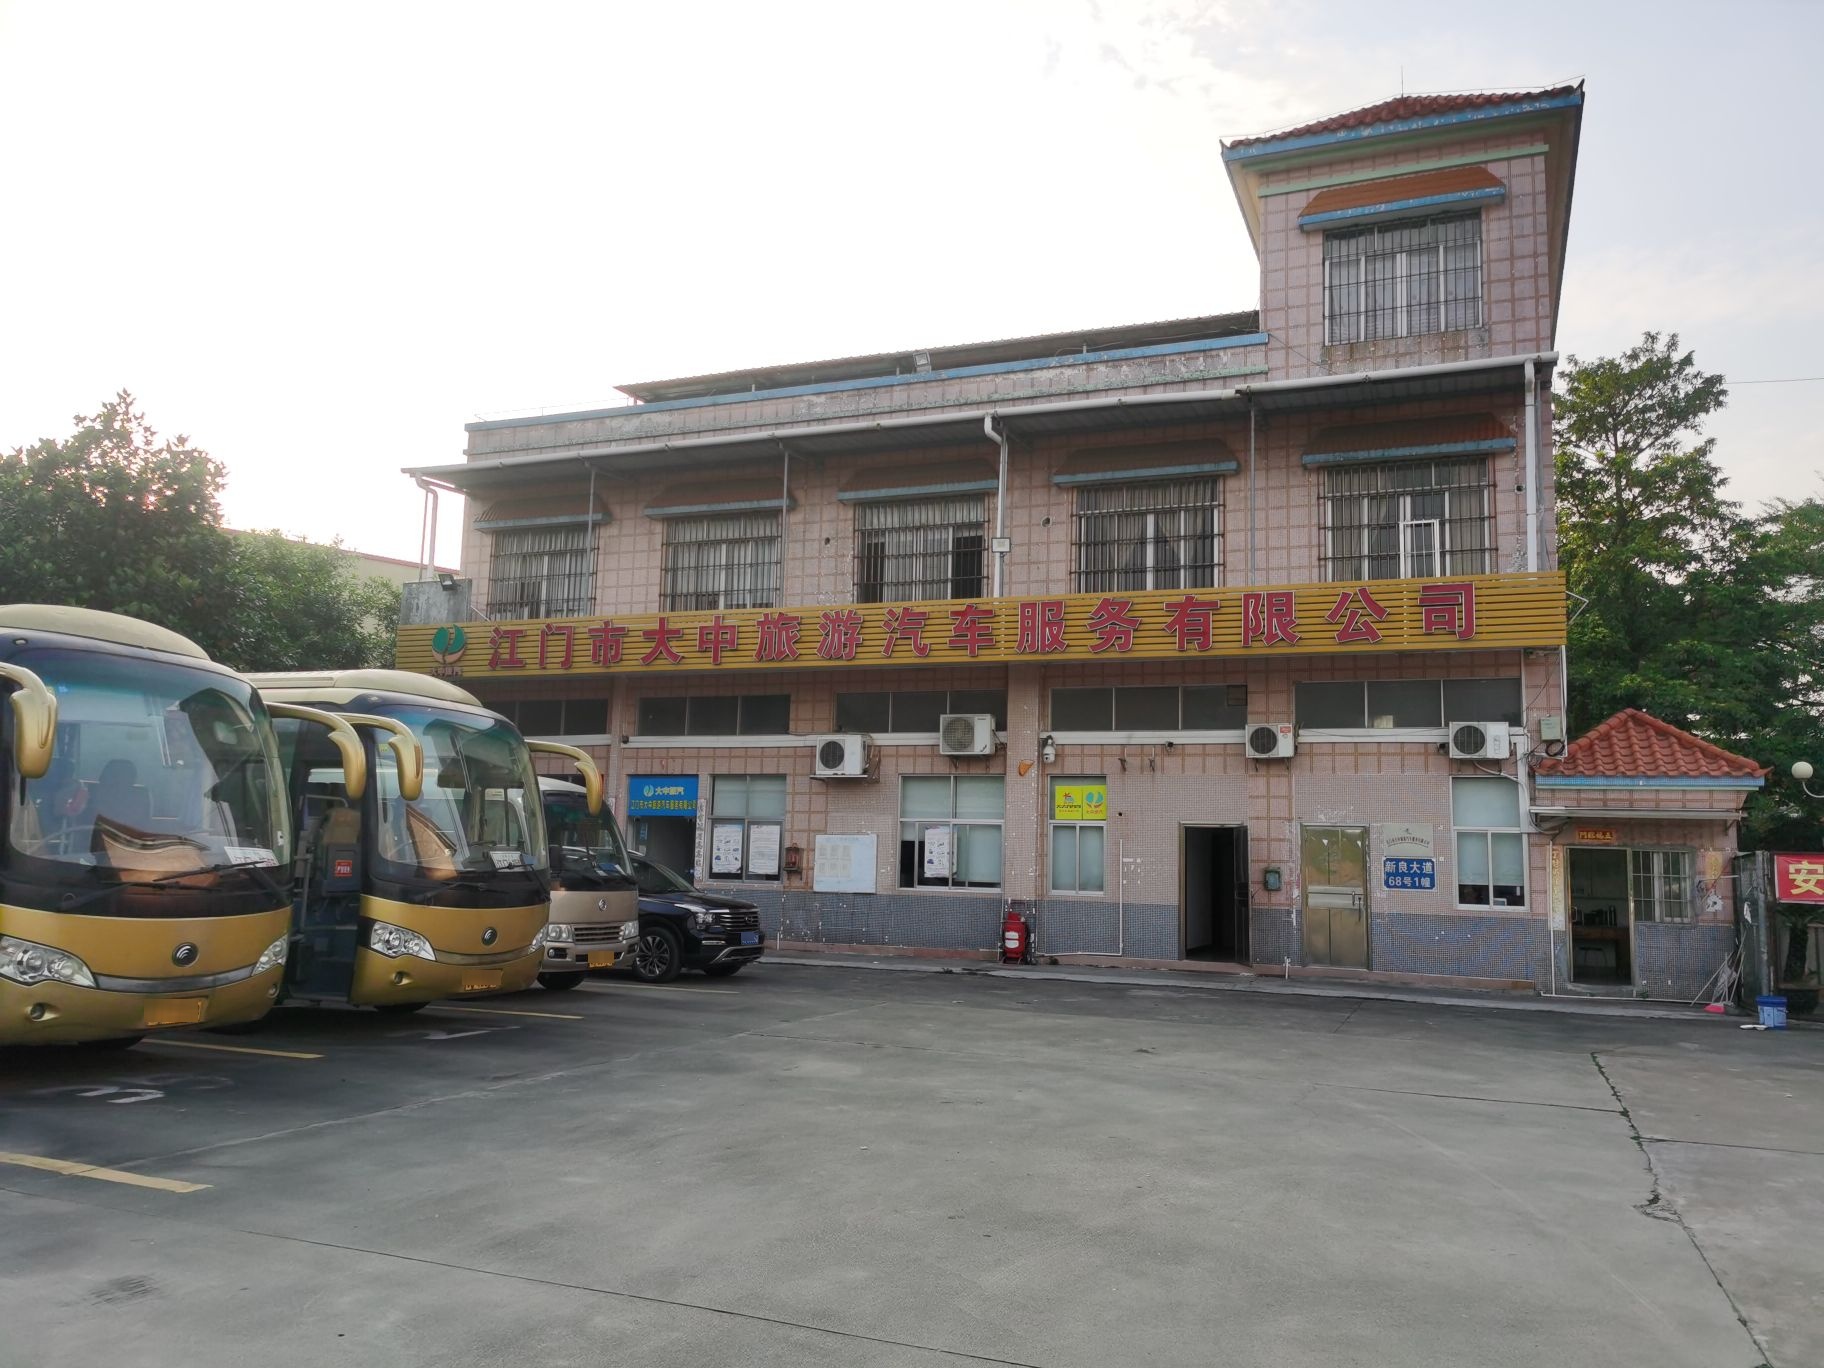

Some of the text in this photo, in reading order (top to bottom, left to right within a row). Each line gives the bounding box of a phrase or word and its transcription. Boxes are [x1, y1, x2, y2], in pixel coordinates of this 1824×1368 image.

[488, 582, 1476, 669] 江门市大中旅游汽车服务有限公司
[1385, 861, 1433, 874] 新良大道
[1789, 860, 1824, 895] 安
[1388, 876, 1431, 888] 68号1幢
